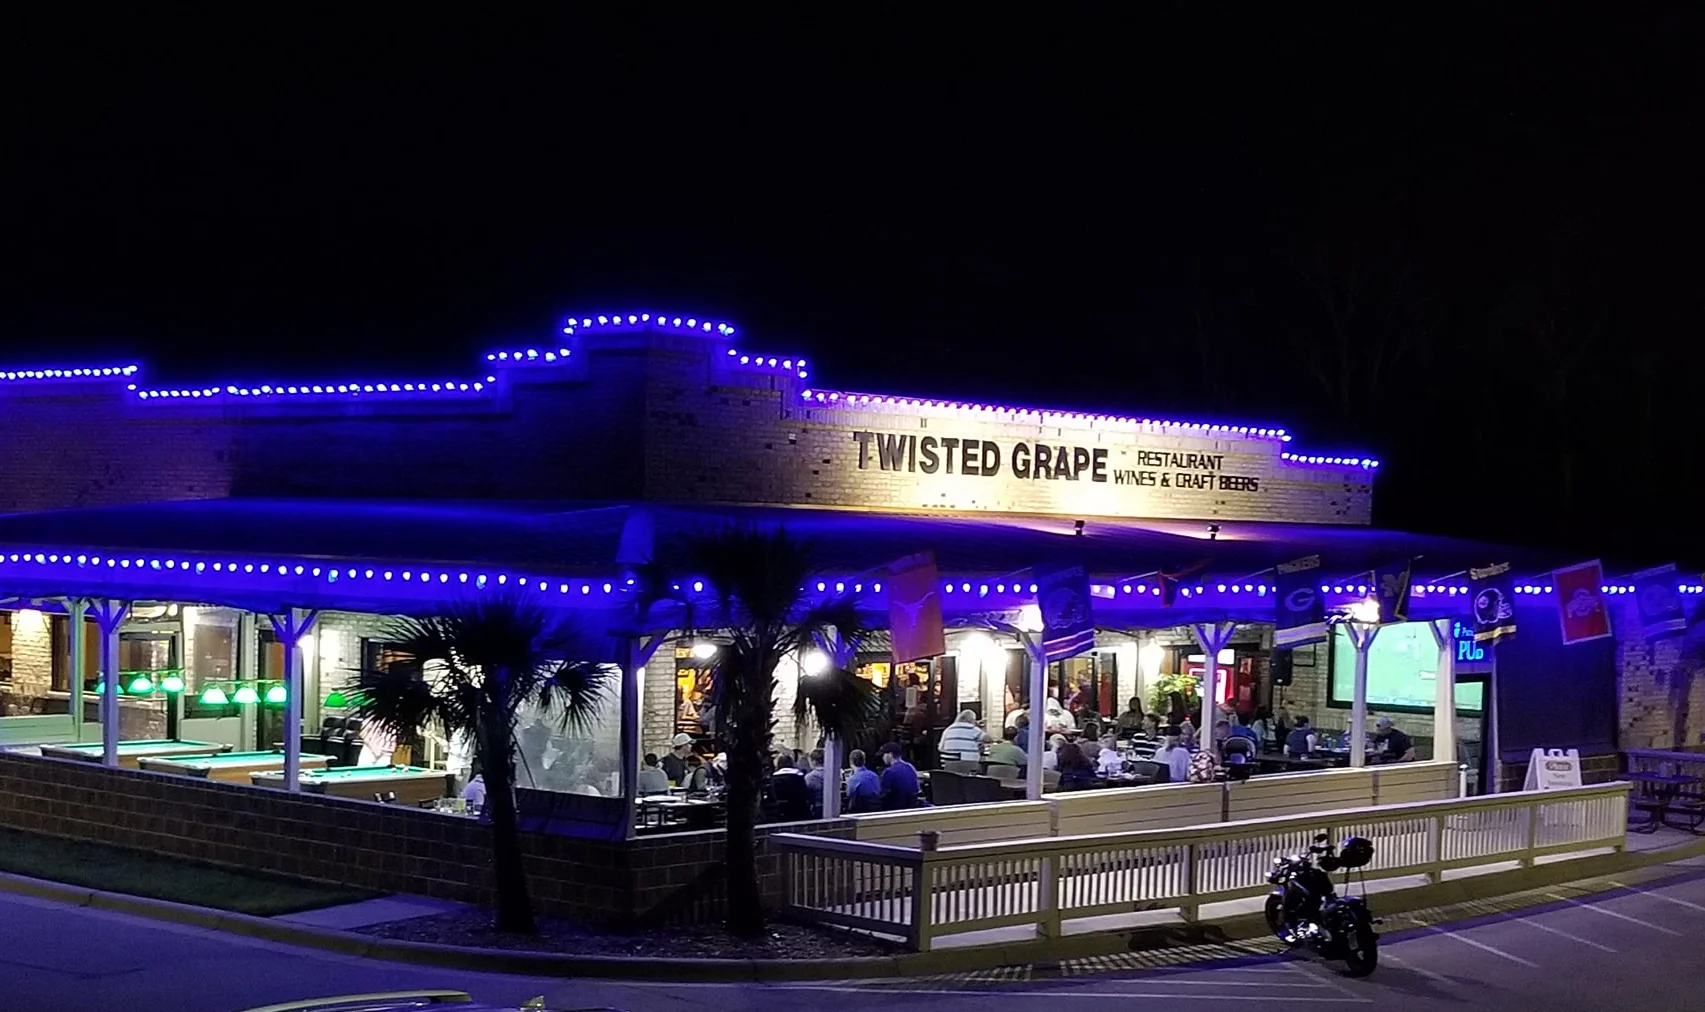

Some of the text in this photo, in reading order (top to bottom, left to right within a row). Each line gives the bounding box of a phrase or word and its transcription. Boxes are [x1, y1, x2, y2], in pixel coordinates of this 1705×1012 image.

[853, 431, 1108, 482] TWISTED GRAPE
[1138, 450, 1224, 470] RESTAURANT
[1114, 469, 1260, 492] WINES & CRAFT BEERS
